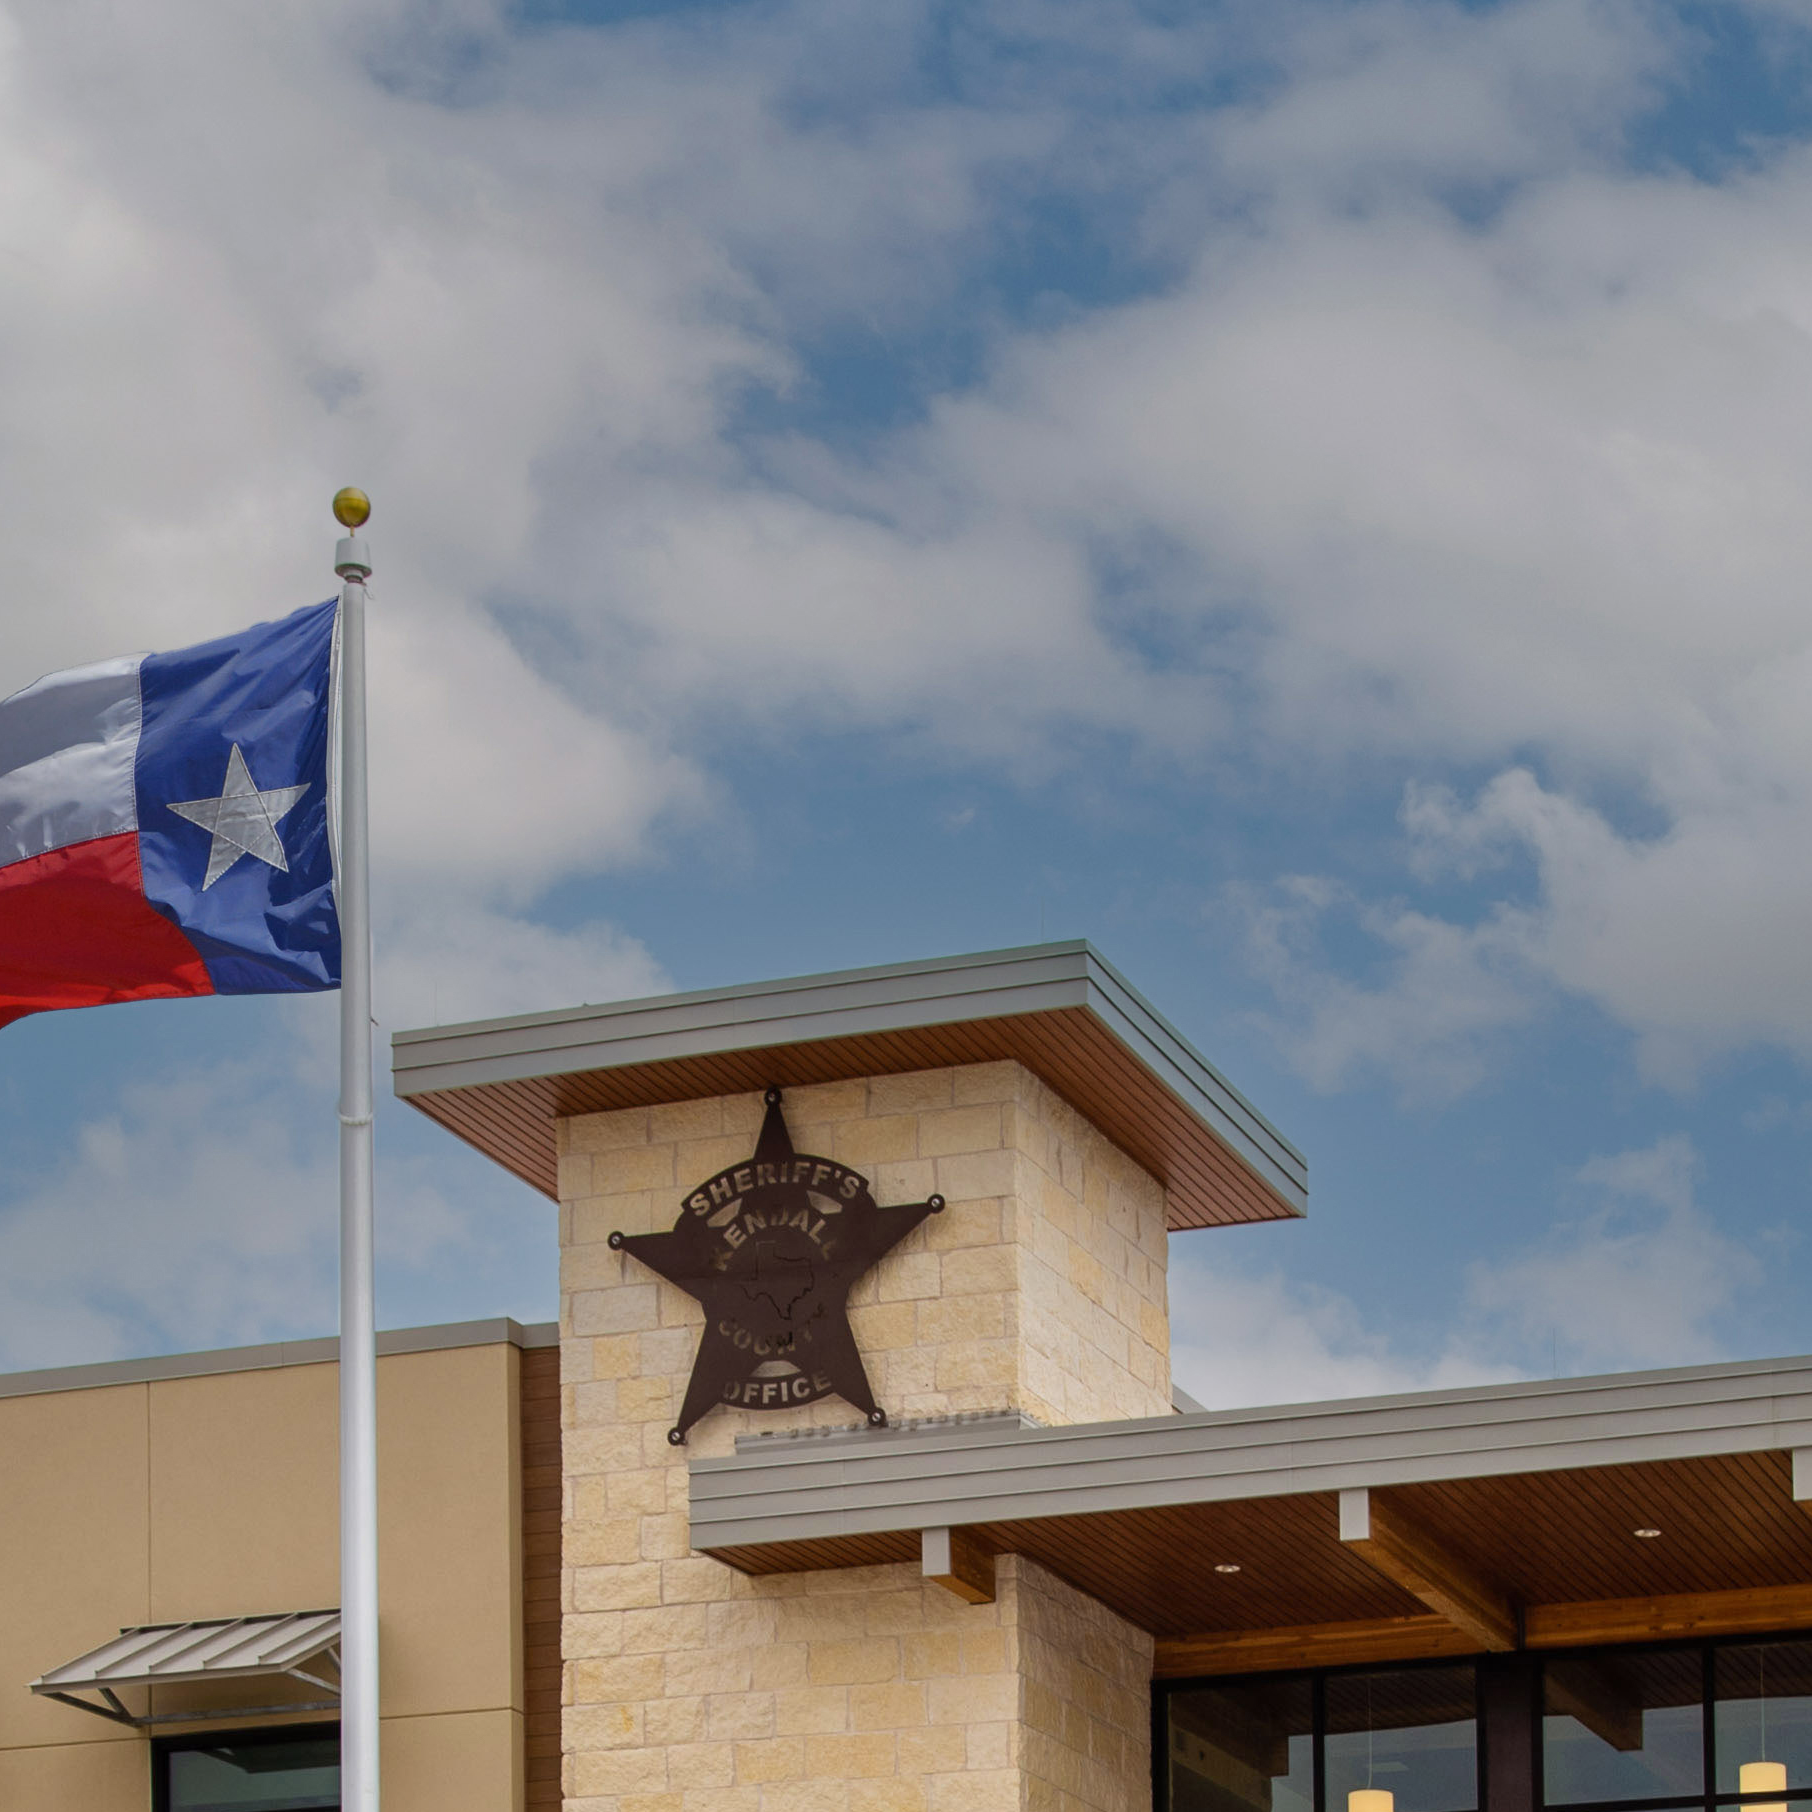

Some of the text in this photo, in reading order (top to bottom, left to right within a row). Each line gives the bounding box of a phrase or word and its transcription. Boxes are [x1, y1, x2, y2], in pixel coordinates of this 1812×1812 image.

[690, 1161, 860, 1216] SHERIFF'S
[719, 1303, 827, 1355] COUN
[723, 1371, 832, 1404] OFFICE
